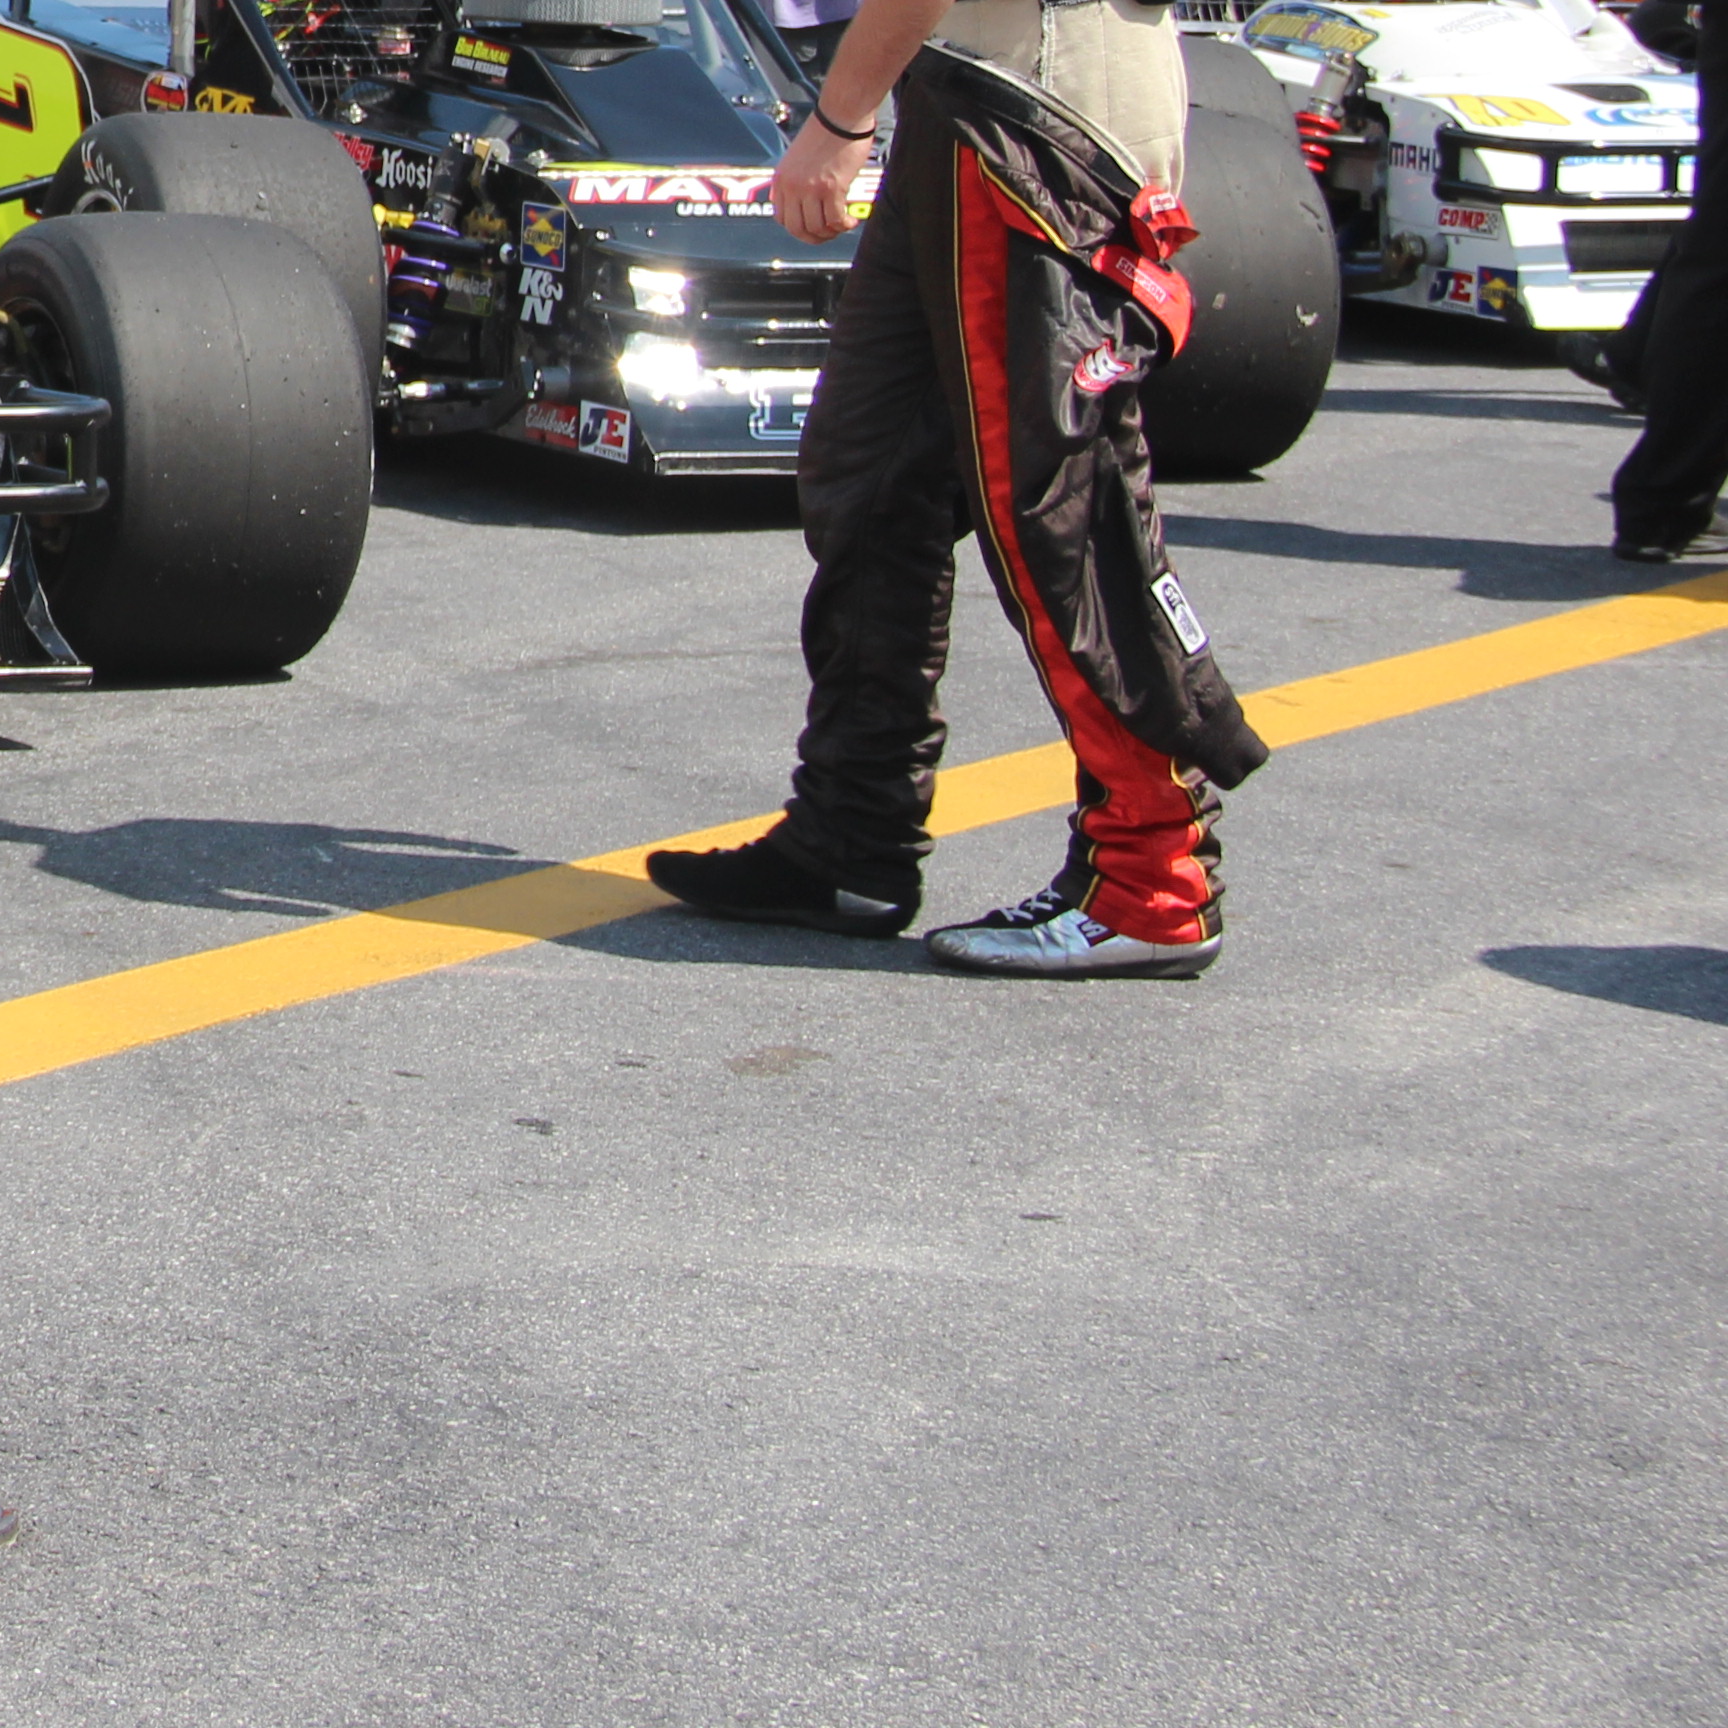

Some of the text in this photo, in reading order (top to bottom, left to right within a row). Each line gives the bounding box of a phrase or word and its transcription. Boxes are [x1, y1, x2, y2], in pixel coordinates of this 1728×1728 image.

[375, 147, 434, 190] Hoosi
[1389, 141, 1441, 175] MAHL
[568, 174, 885, 205] MAYE
[675, 203, 776, 218] USA MAD
[1438, 208, 1485, 229] COMP
[1428, 270, 1474, 303] JE
[524, 404, 627, 449] Edelbrock JE
